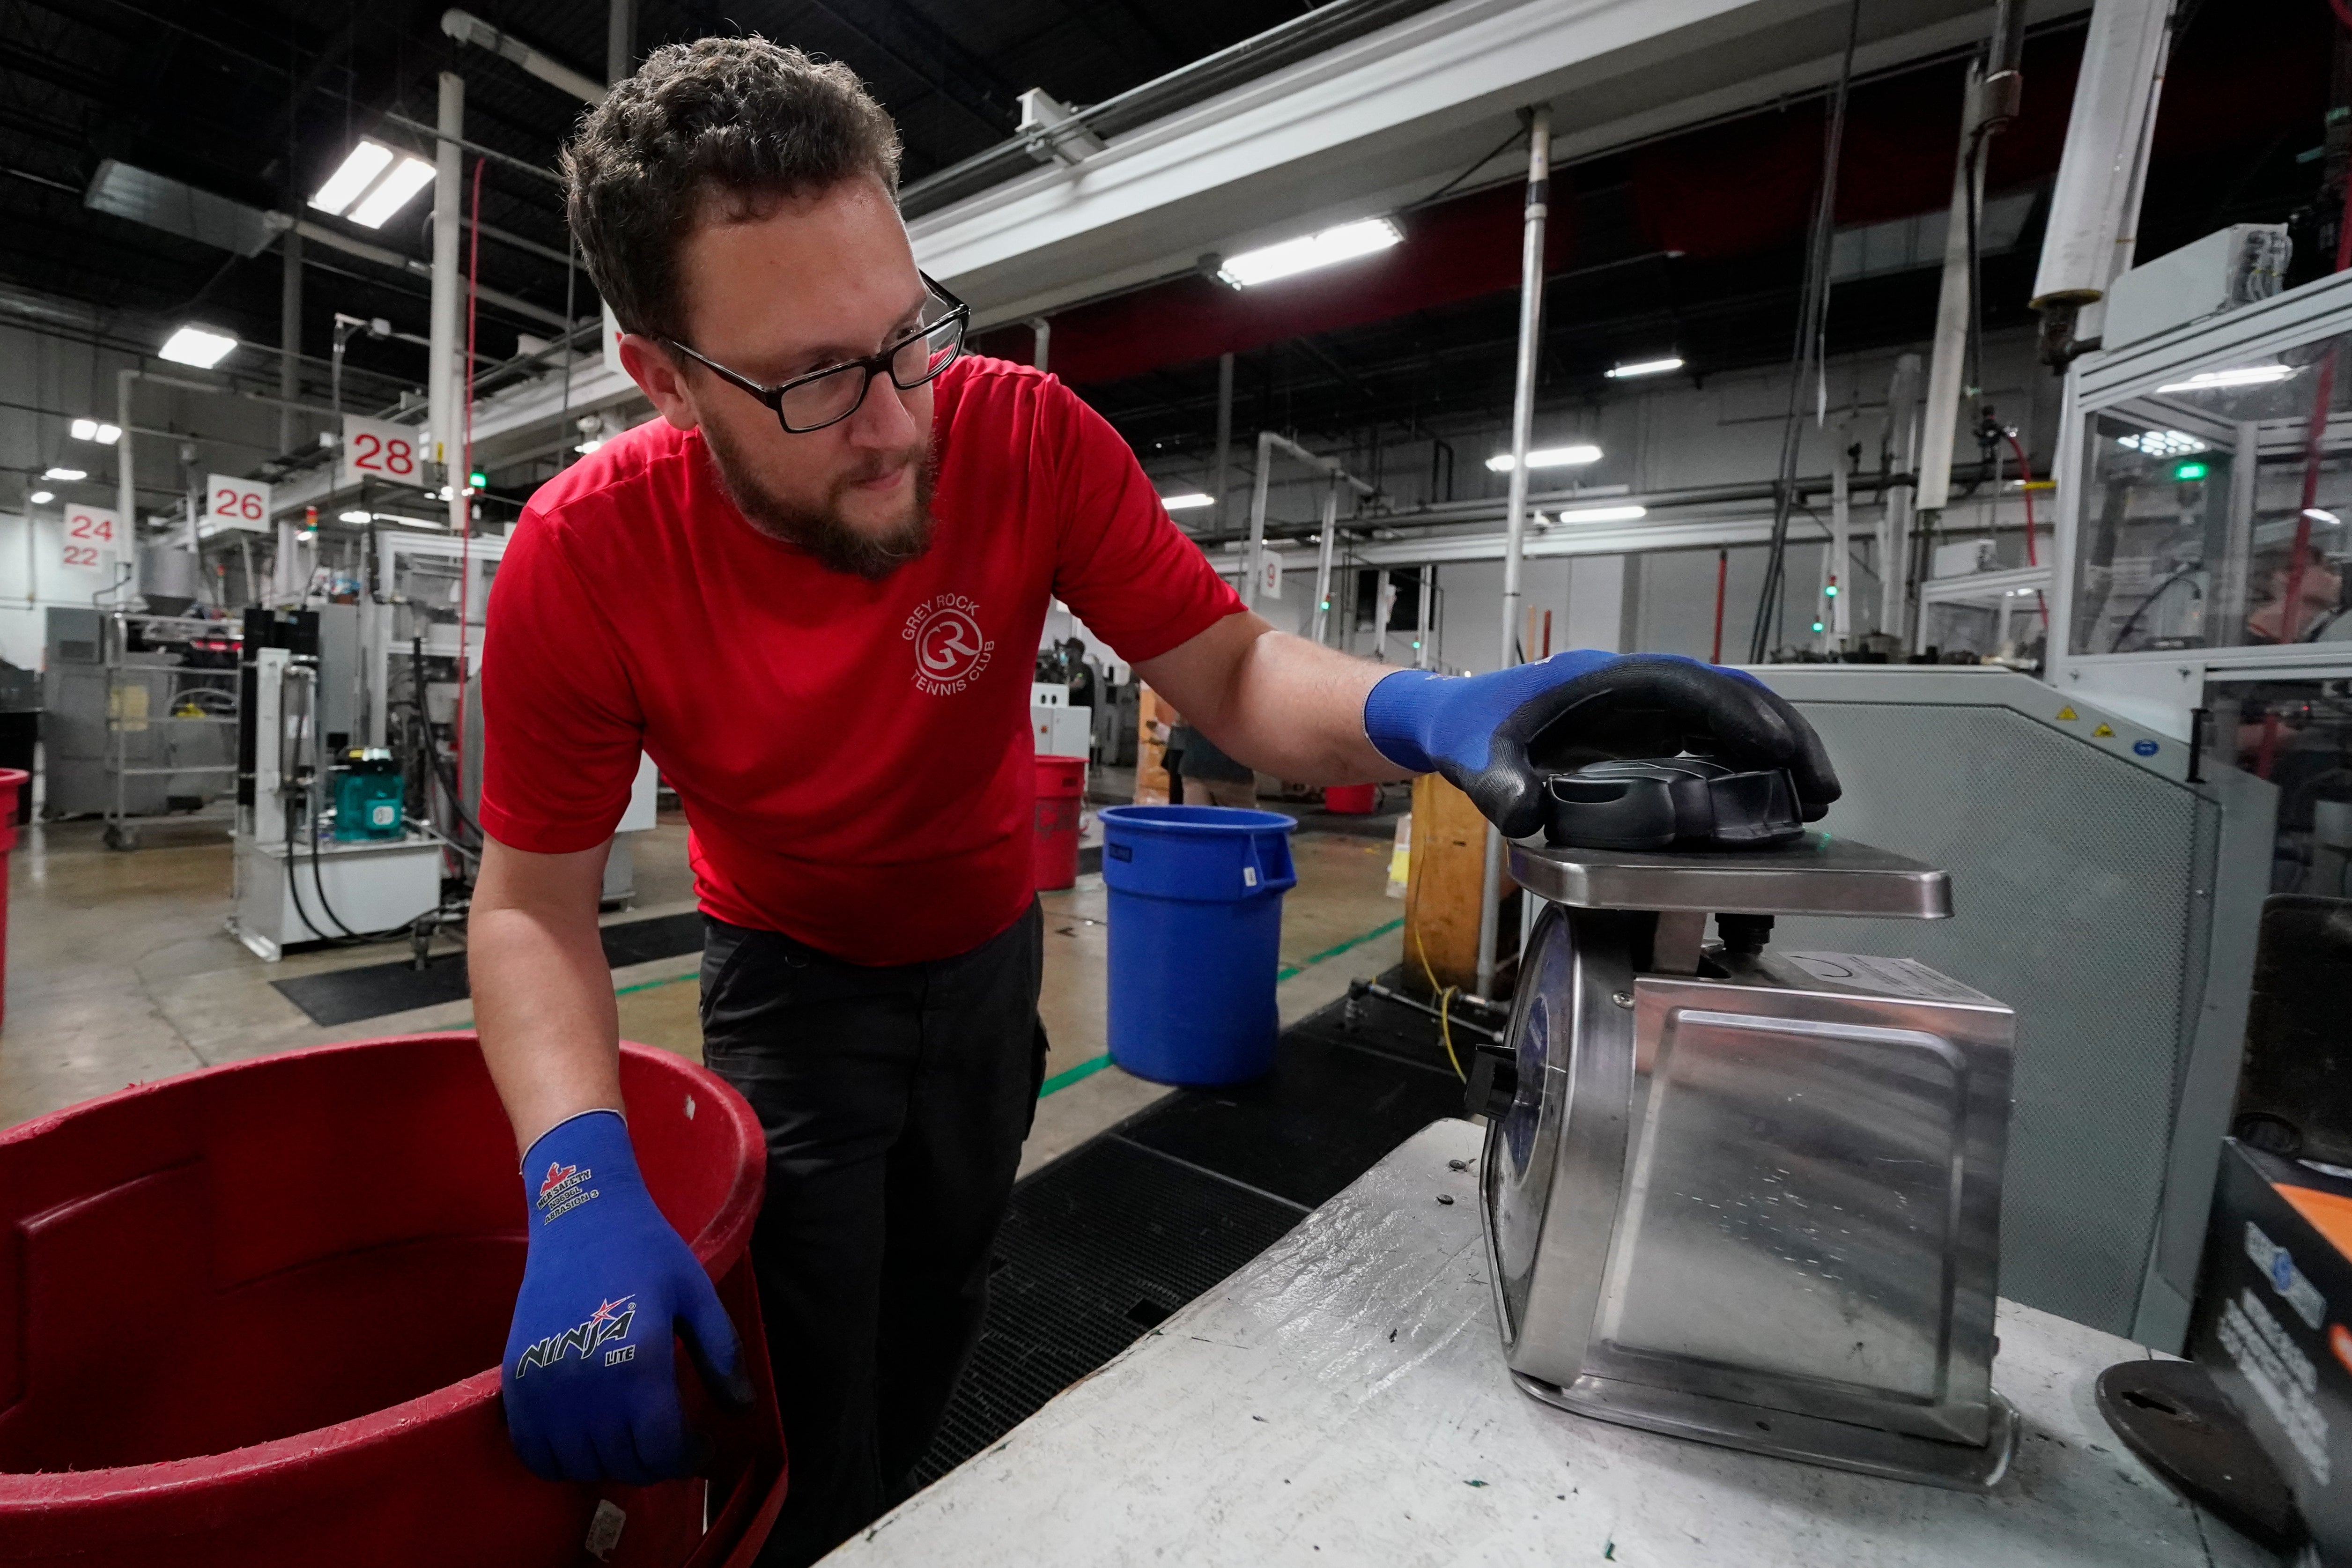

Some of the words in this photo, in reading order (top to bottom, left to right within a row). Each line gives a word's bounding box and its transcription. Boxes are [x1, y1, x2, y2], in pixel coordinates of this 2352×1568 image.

[355, 434, 413, 475] 28
[216, 489, 263, 520] 26
[71, 515, 112, 541] 24
[63, 545, 98, 566] 22
[901, 599, 932, 641] GREY
[936, 592, 981, 617] ROCK
[910, 669, 967, 696] TENNIS
[969, 640, 995, 681] CLUB
[537, 1190, 554, 1210] MCR
[545, 1193, 590, 1225] ABRASION
[516, 1310, 636, 1379] NINJA
[605, 1344, 636, 1367] LITE
